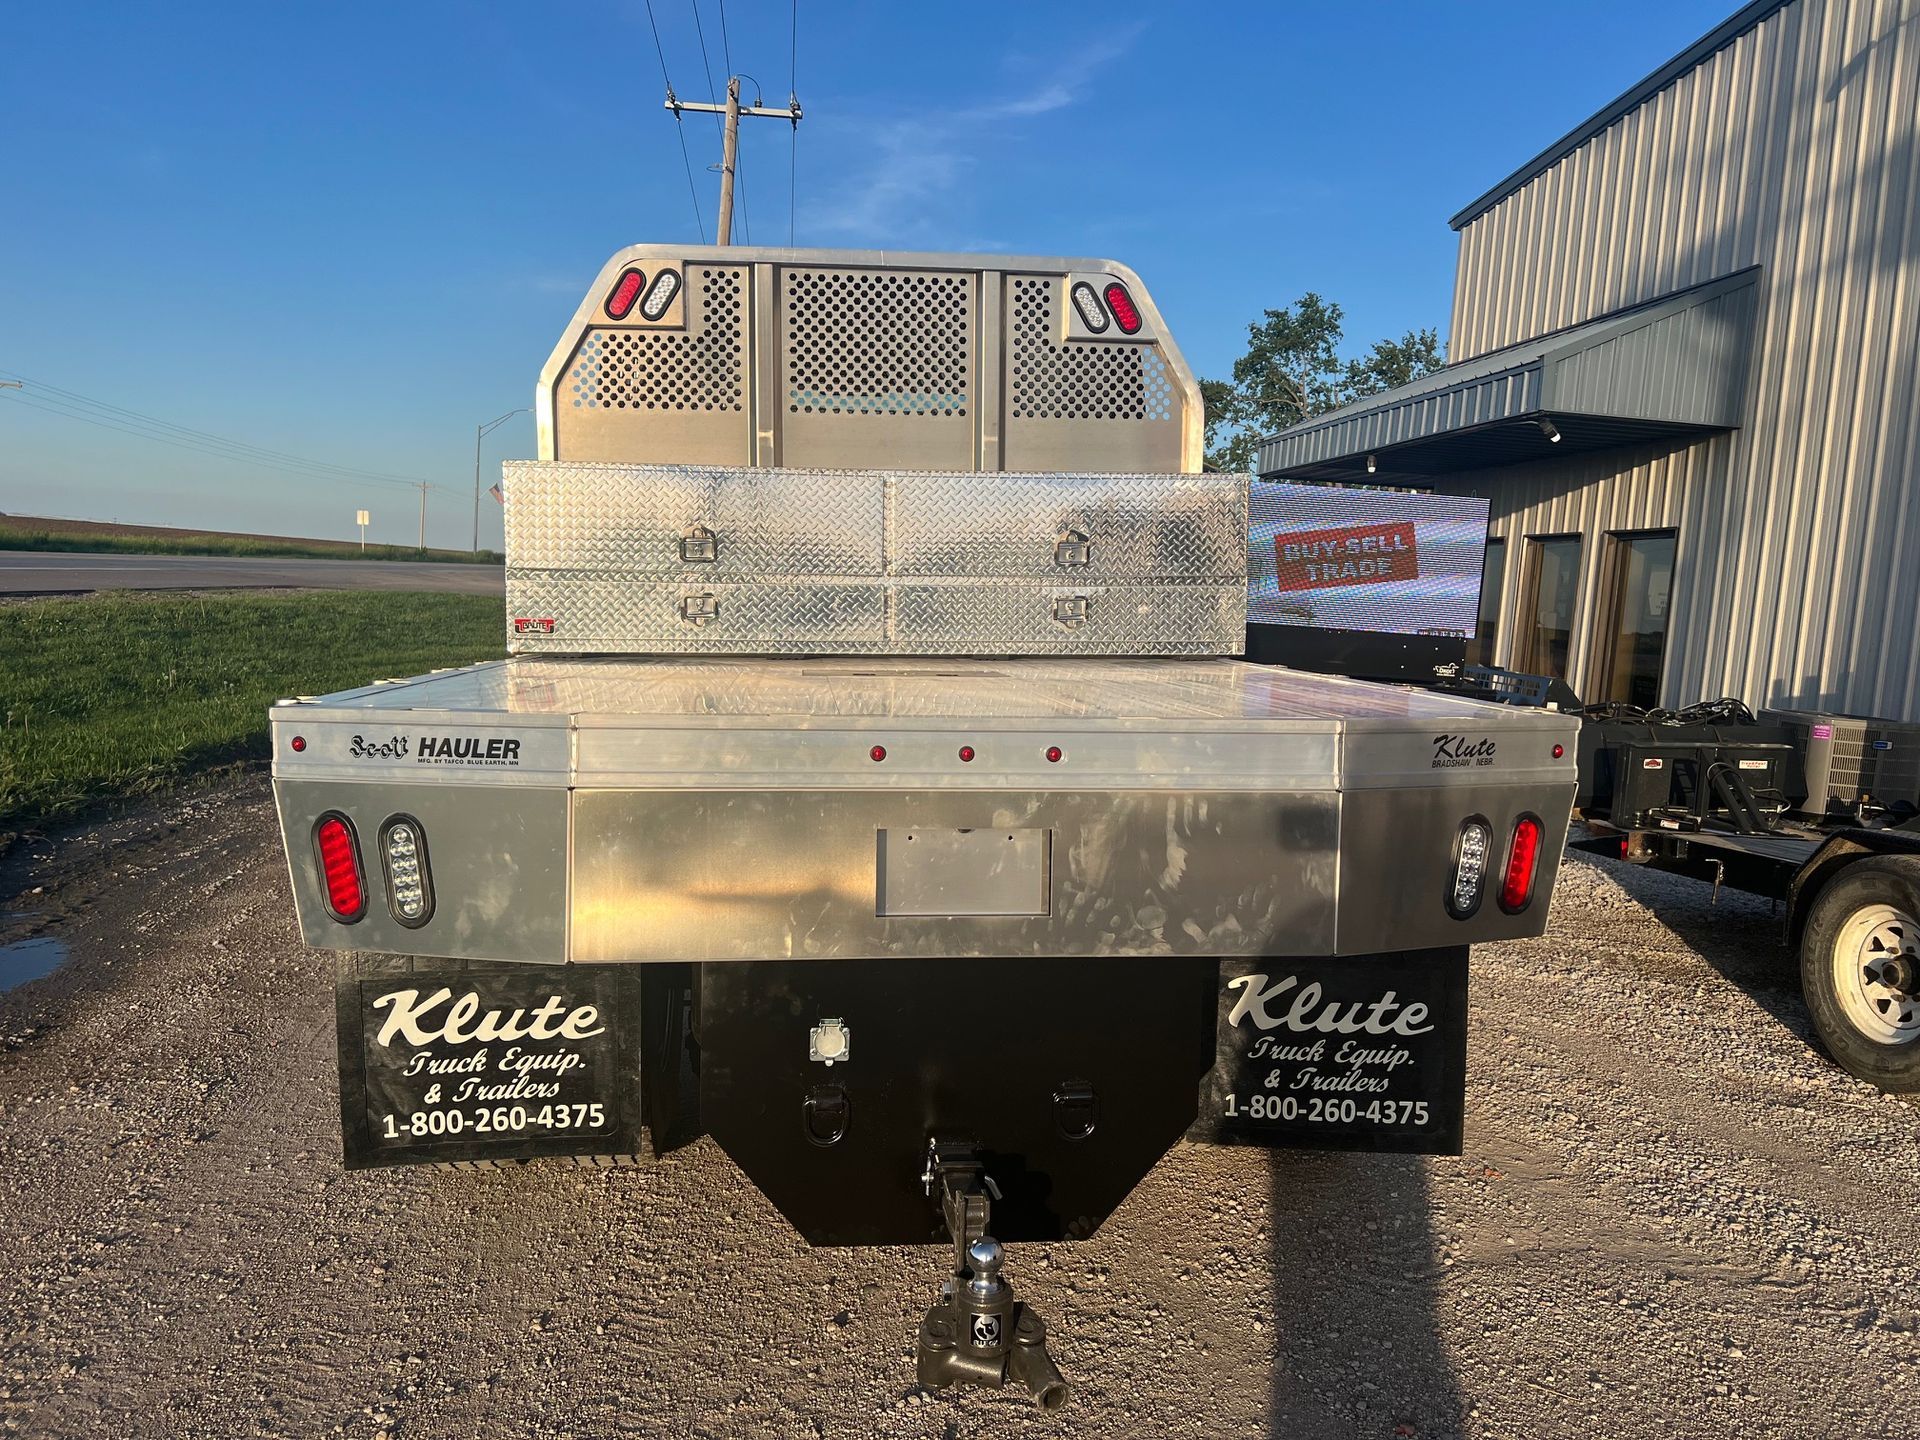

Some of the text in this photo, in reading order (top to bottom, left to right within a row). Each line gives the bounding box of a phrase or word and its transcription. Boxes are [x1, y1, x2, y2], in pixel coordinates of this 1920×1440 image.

[1284, 535, 1408, 561] BUY-SELL
[1305, 557, 1392, 581] TRADE
[350, 734, 521, 759] Scott HAULER
[1433, 734, 1496, 759] Klute
[1431, 758, 1471, 769] BRADSHAW
[372, 987, 606, 1048] Klute
[1227, 973, 1435, 1036] Klute
[402, 1047, 586, 1079] Truck Equip.
[1247, 1036, 1415, 1073] Truck Equip.
[423, 1076, 560, 1105] & Trailers
[1264, 1067, 1390, 1093] & Trailers
[382, 1102, 606, 1139] 1-800-260-4375
[1224, 1093, 1430, 1126] 1-800-260-4375
